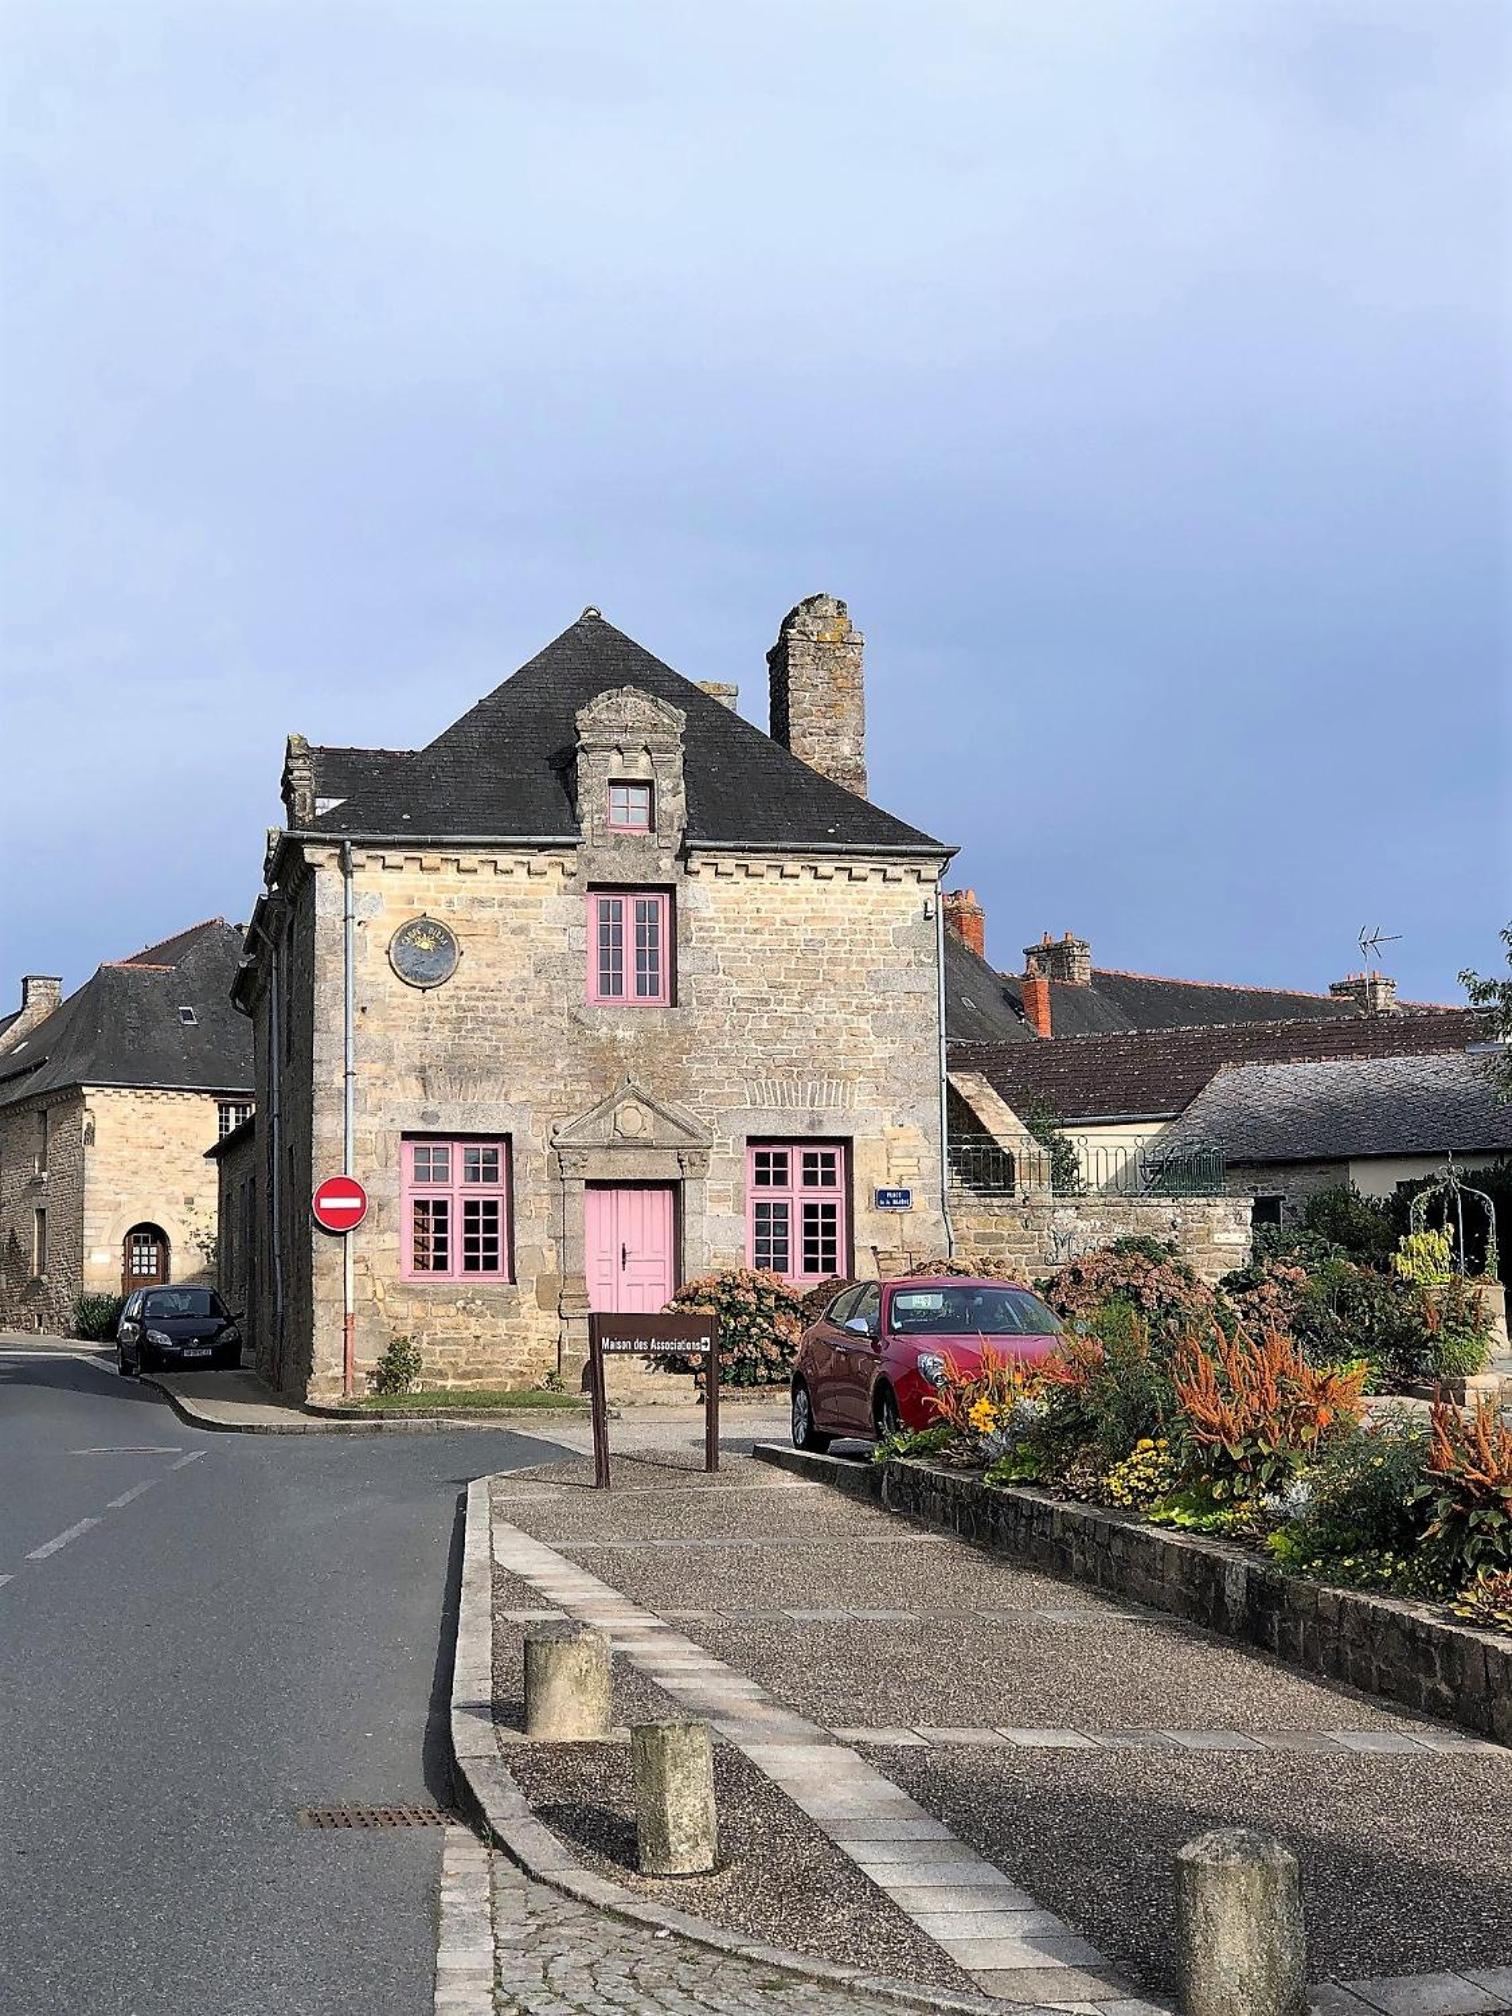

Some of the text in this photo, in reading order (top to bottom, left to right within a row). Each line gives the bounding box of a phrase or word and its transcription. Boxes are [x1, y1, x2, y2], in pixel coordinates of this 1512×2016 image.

[601, 1337, 701, 1350] Maison des Associations
